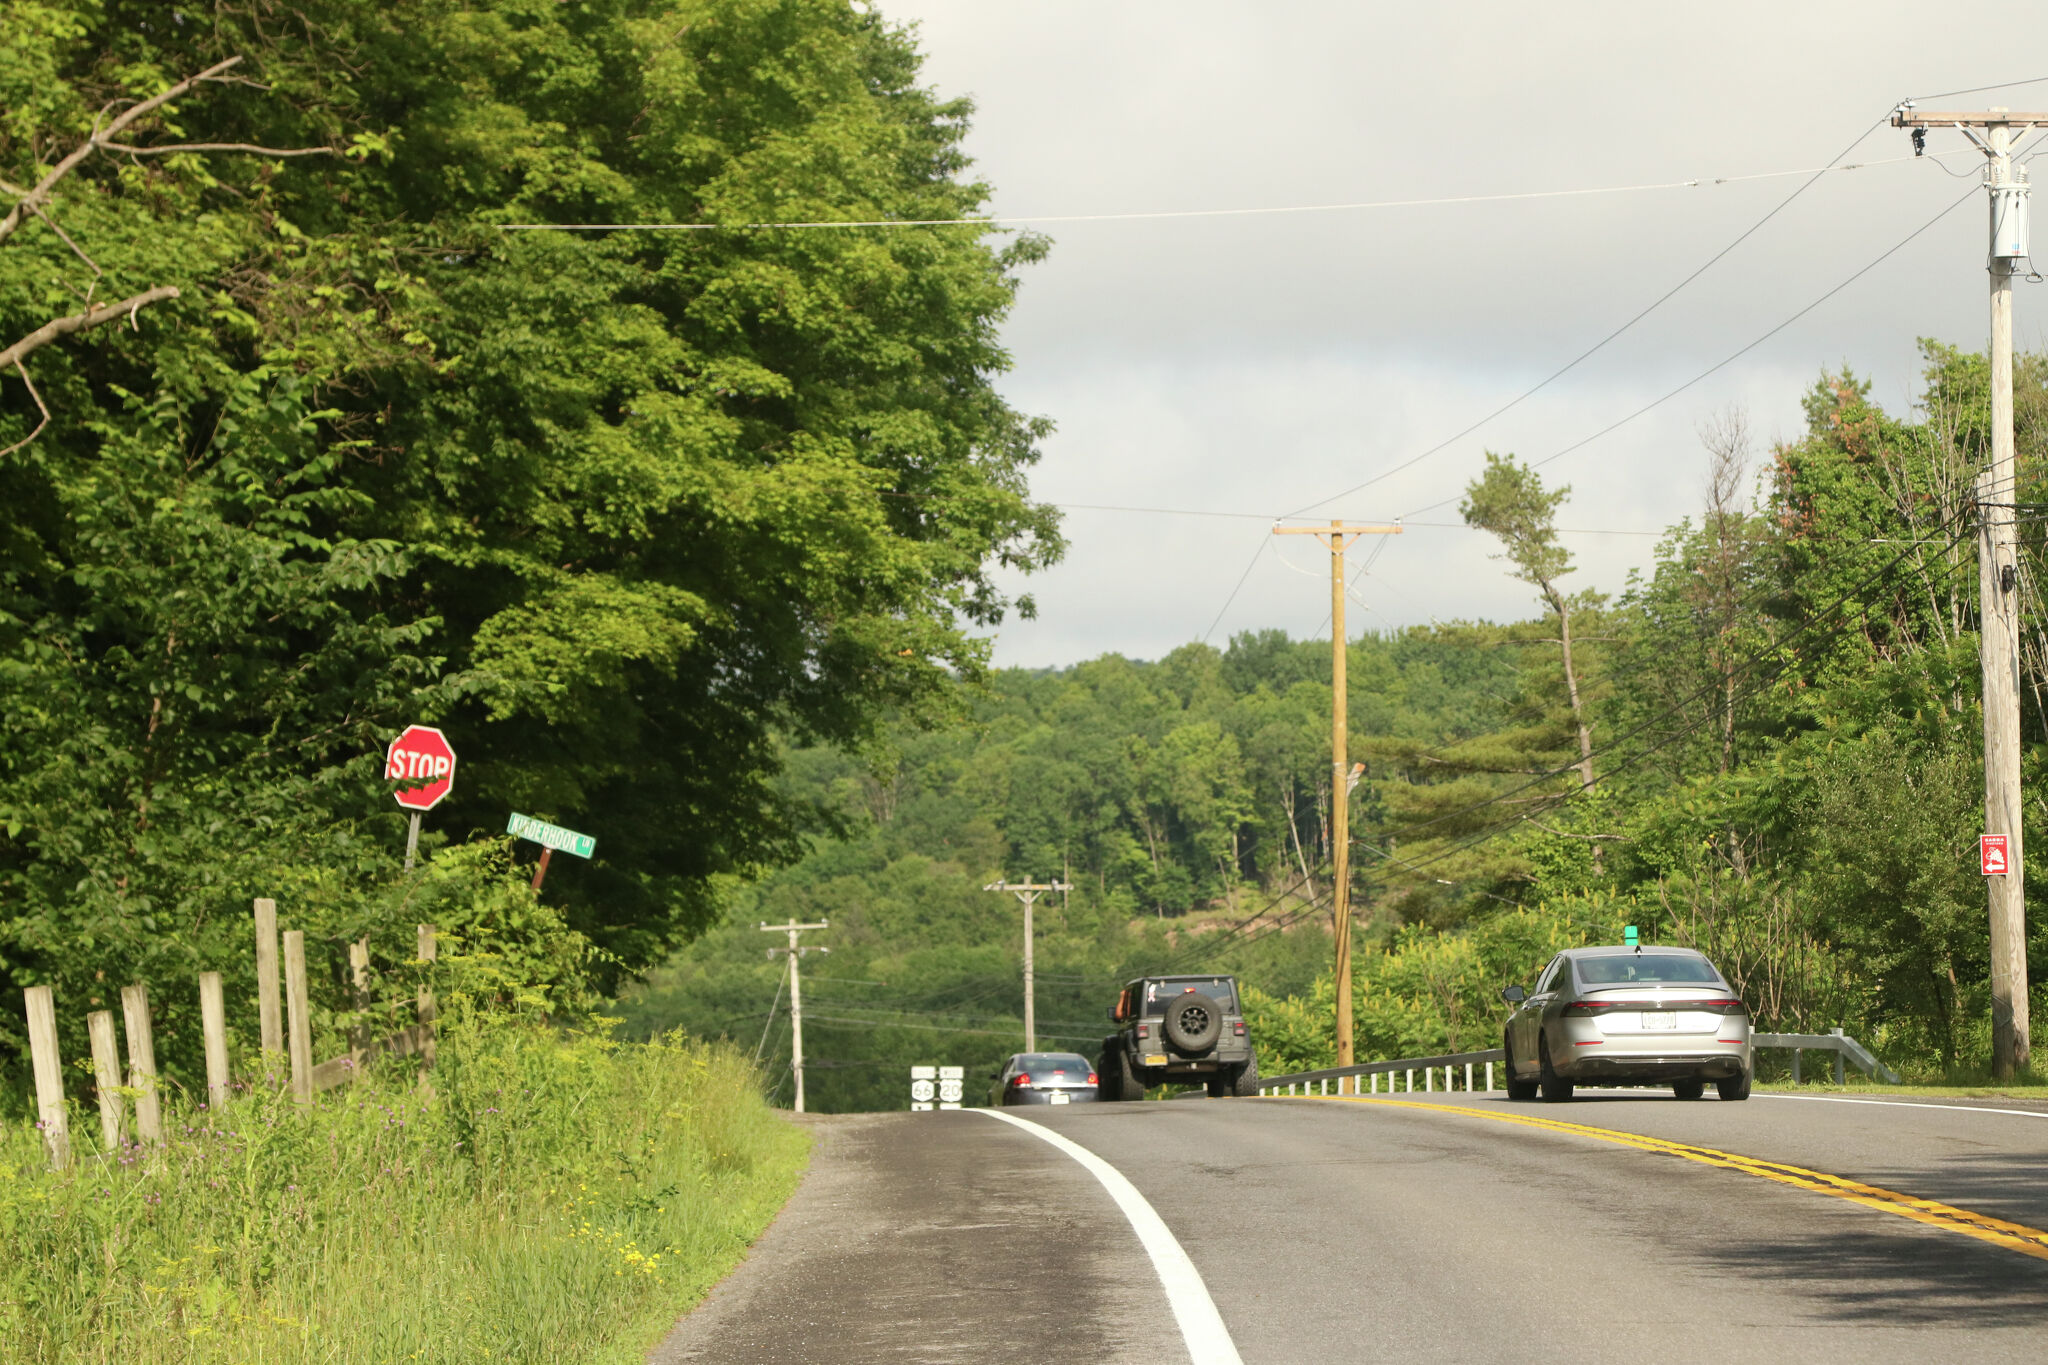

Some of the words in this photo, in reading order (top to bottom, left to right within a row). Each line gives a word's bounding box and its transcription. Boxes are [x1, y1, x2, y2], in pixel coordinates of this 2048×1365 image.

[391, 748, 450, 780] STOP
[511, 815, 579, 852] KINDERHOOK
[914, 1084, 931, 1097] 66
[942, 1084, 960, 1097] 20
